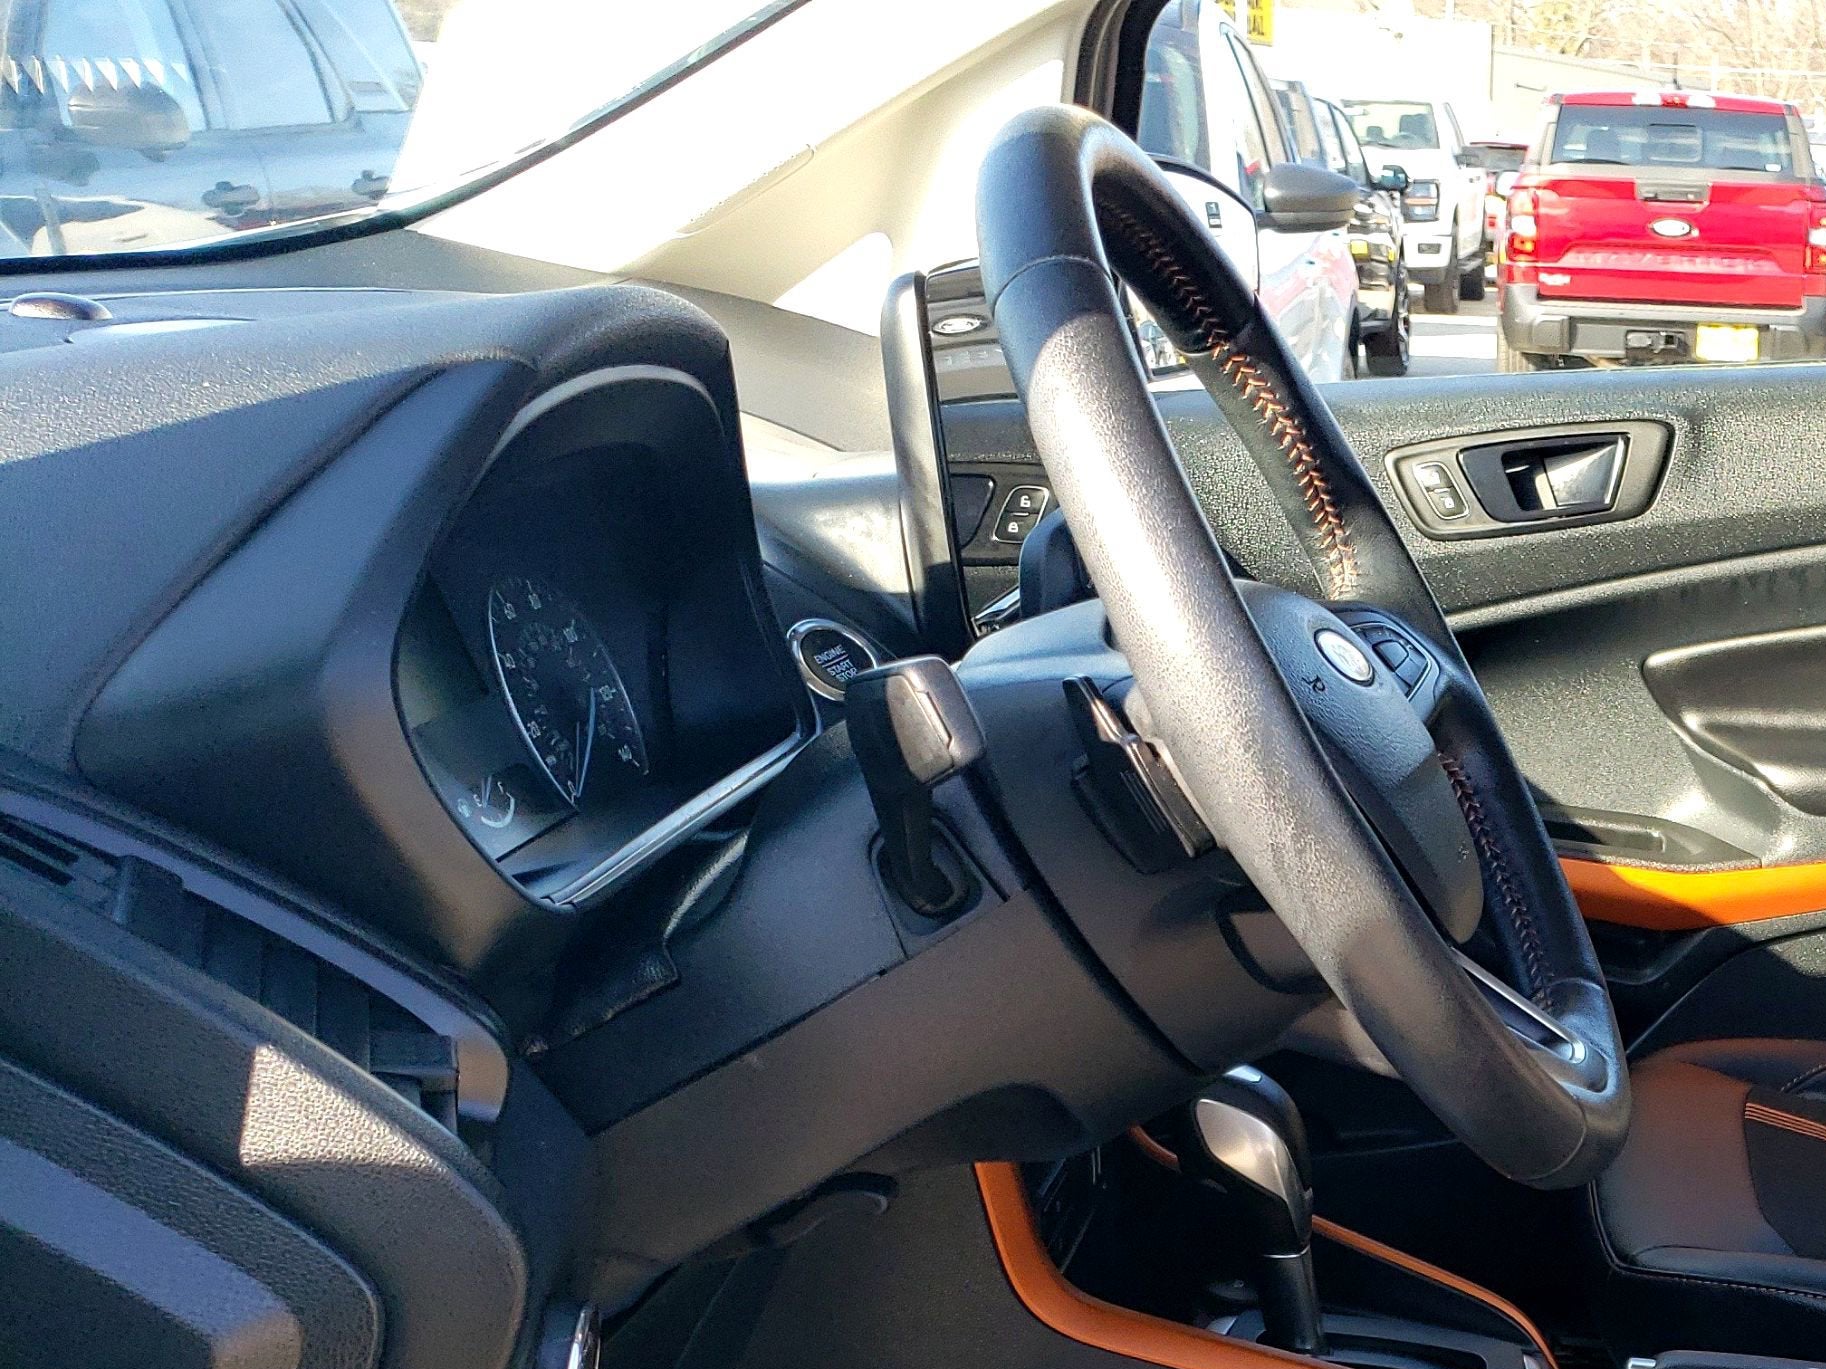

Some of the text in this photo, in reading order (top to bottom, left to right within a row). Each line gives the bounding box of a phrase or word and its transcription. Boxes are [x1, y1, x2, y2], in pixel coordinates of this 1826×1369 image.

[813, 643, 847, 664] ENGINE
[826, 659, 854, 676] START
[835, 667, 859, 682] STOP
